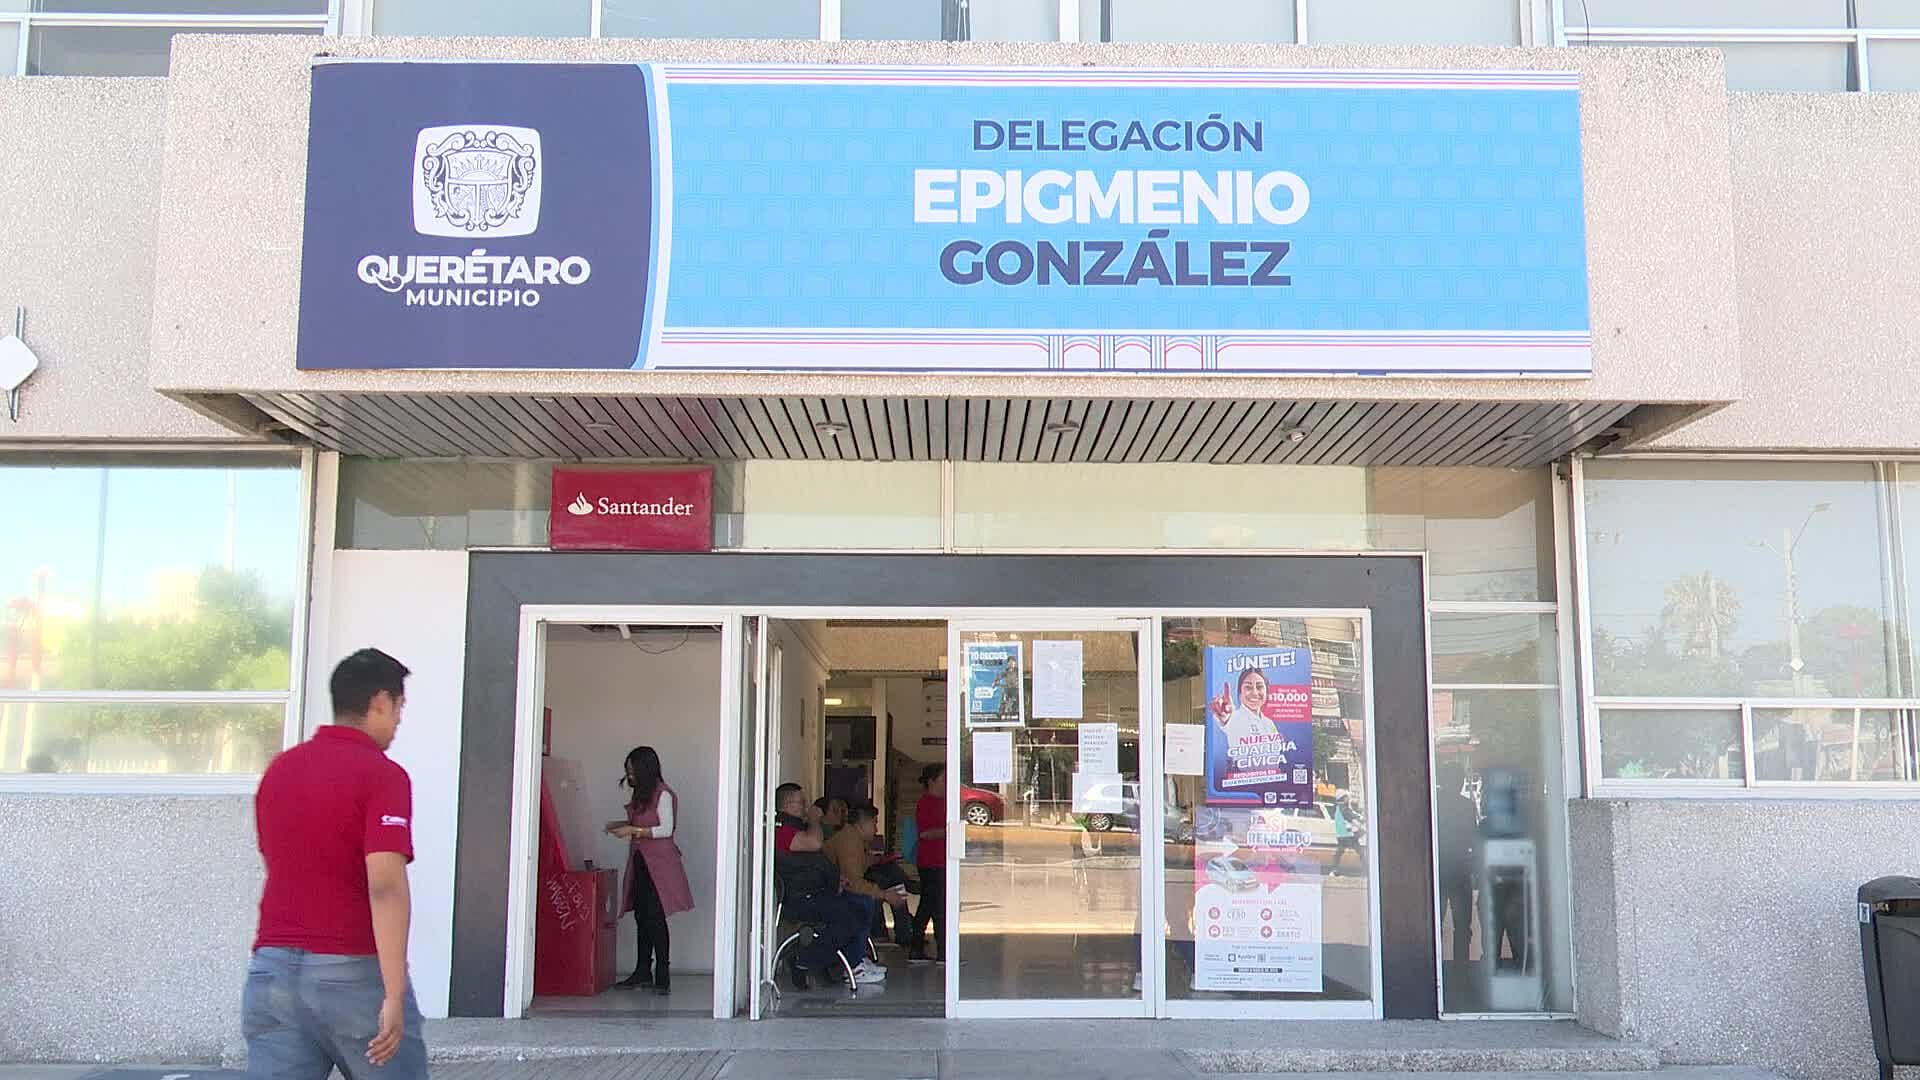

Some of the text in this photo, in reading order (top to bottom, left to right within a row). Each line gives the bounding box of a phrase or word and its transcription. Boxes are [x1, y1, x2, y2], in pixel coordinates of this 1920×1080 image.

[973, 113, 1263, 152] DELEGACIÓN
[914, 168, 1310, 225] EPIGMENIO
[939, 228, 1291, 286] GONZÁLEZ
[357, 248, 591, 292] QUERÉTARO
[406, 289, 540, 307] MUNICIPIO
[597, 497, 694, 516] Santander
[1227, 651, 1296, 673] ¡ÚNETE!
[1227, 741, 1297, 757] GUARDIA
[1239, 733, 1284, 745] NUEVA
